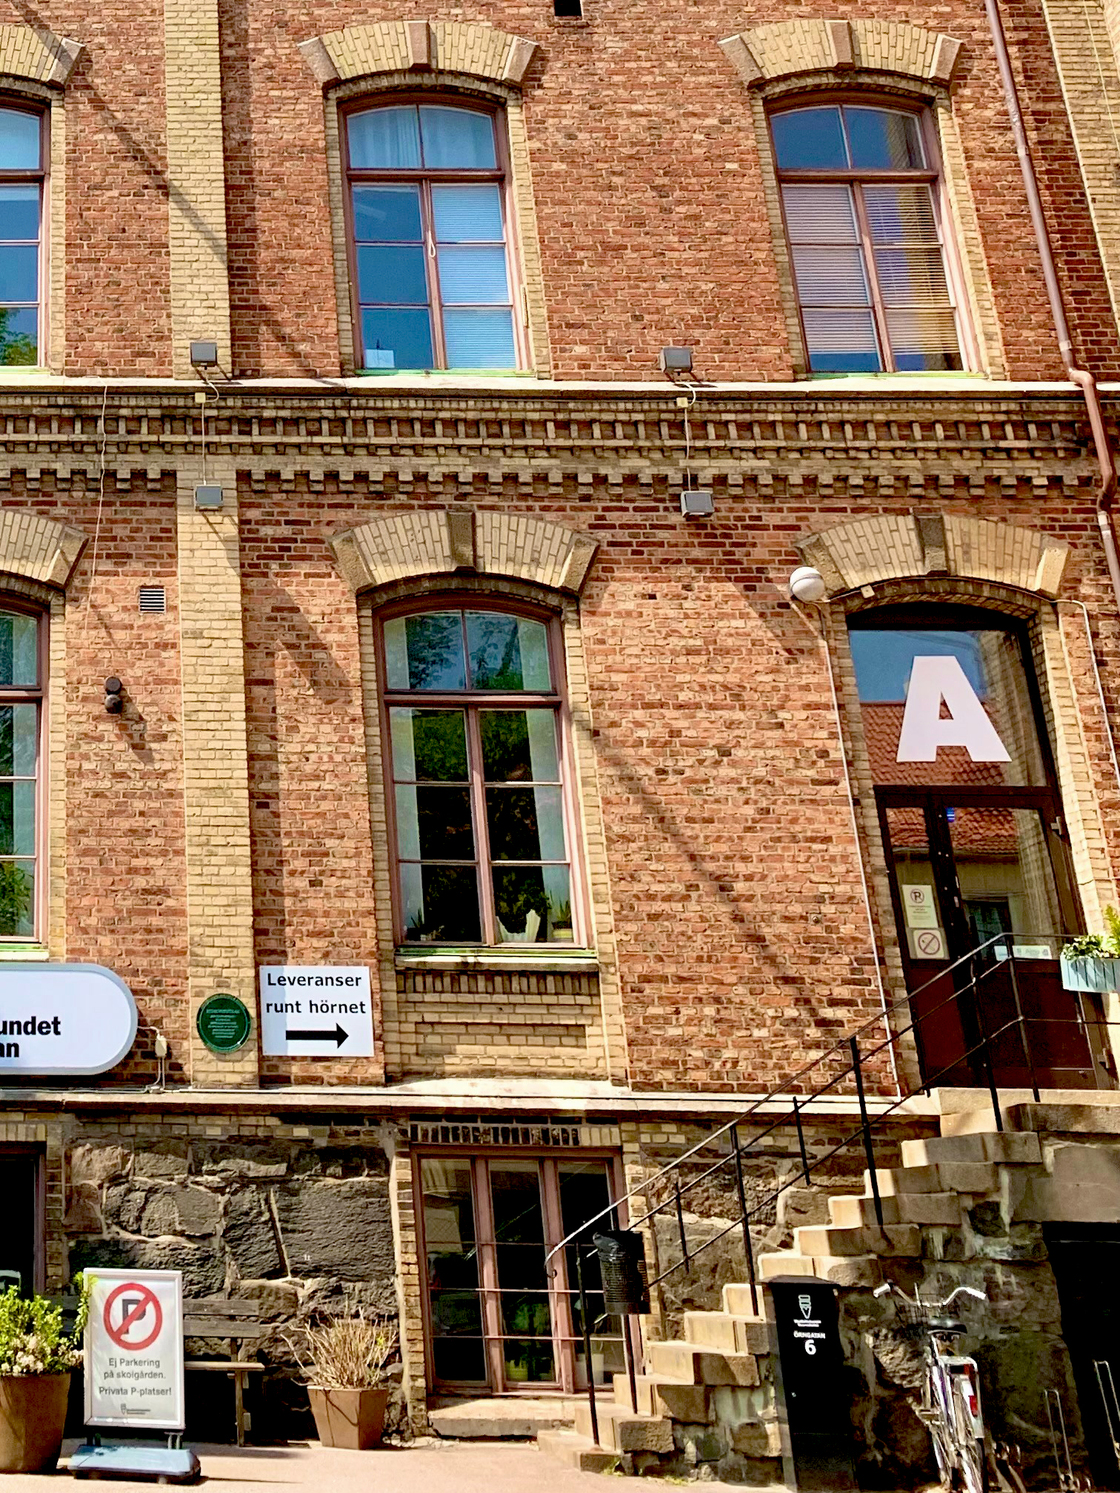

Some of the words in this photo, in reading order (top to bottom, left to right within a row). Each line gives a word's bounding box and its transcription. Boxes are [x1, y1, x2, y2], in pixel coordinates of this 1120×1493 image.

[897, 656, 1012, 762] A
[267, 973, 362, 986] Leveranser
[266, 1001, 301, 1013] runt
[309, 999, 366, 1014] hörnet
[804, 1339, 817, 1355] 6
[108, 1357, 118, 1368] Ej
[119, 1358, 160, 1369] Parkering
[103, 1369, 115, 1380] på
[116, 1370, 166, 1381] skolgården.
